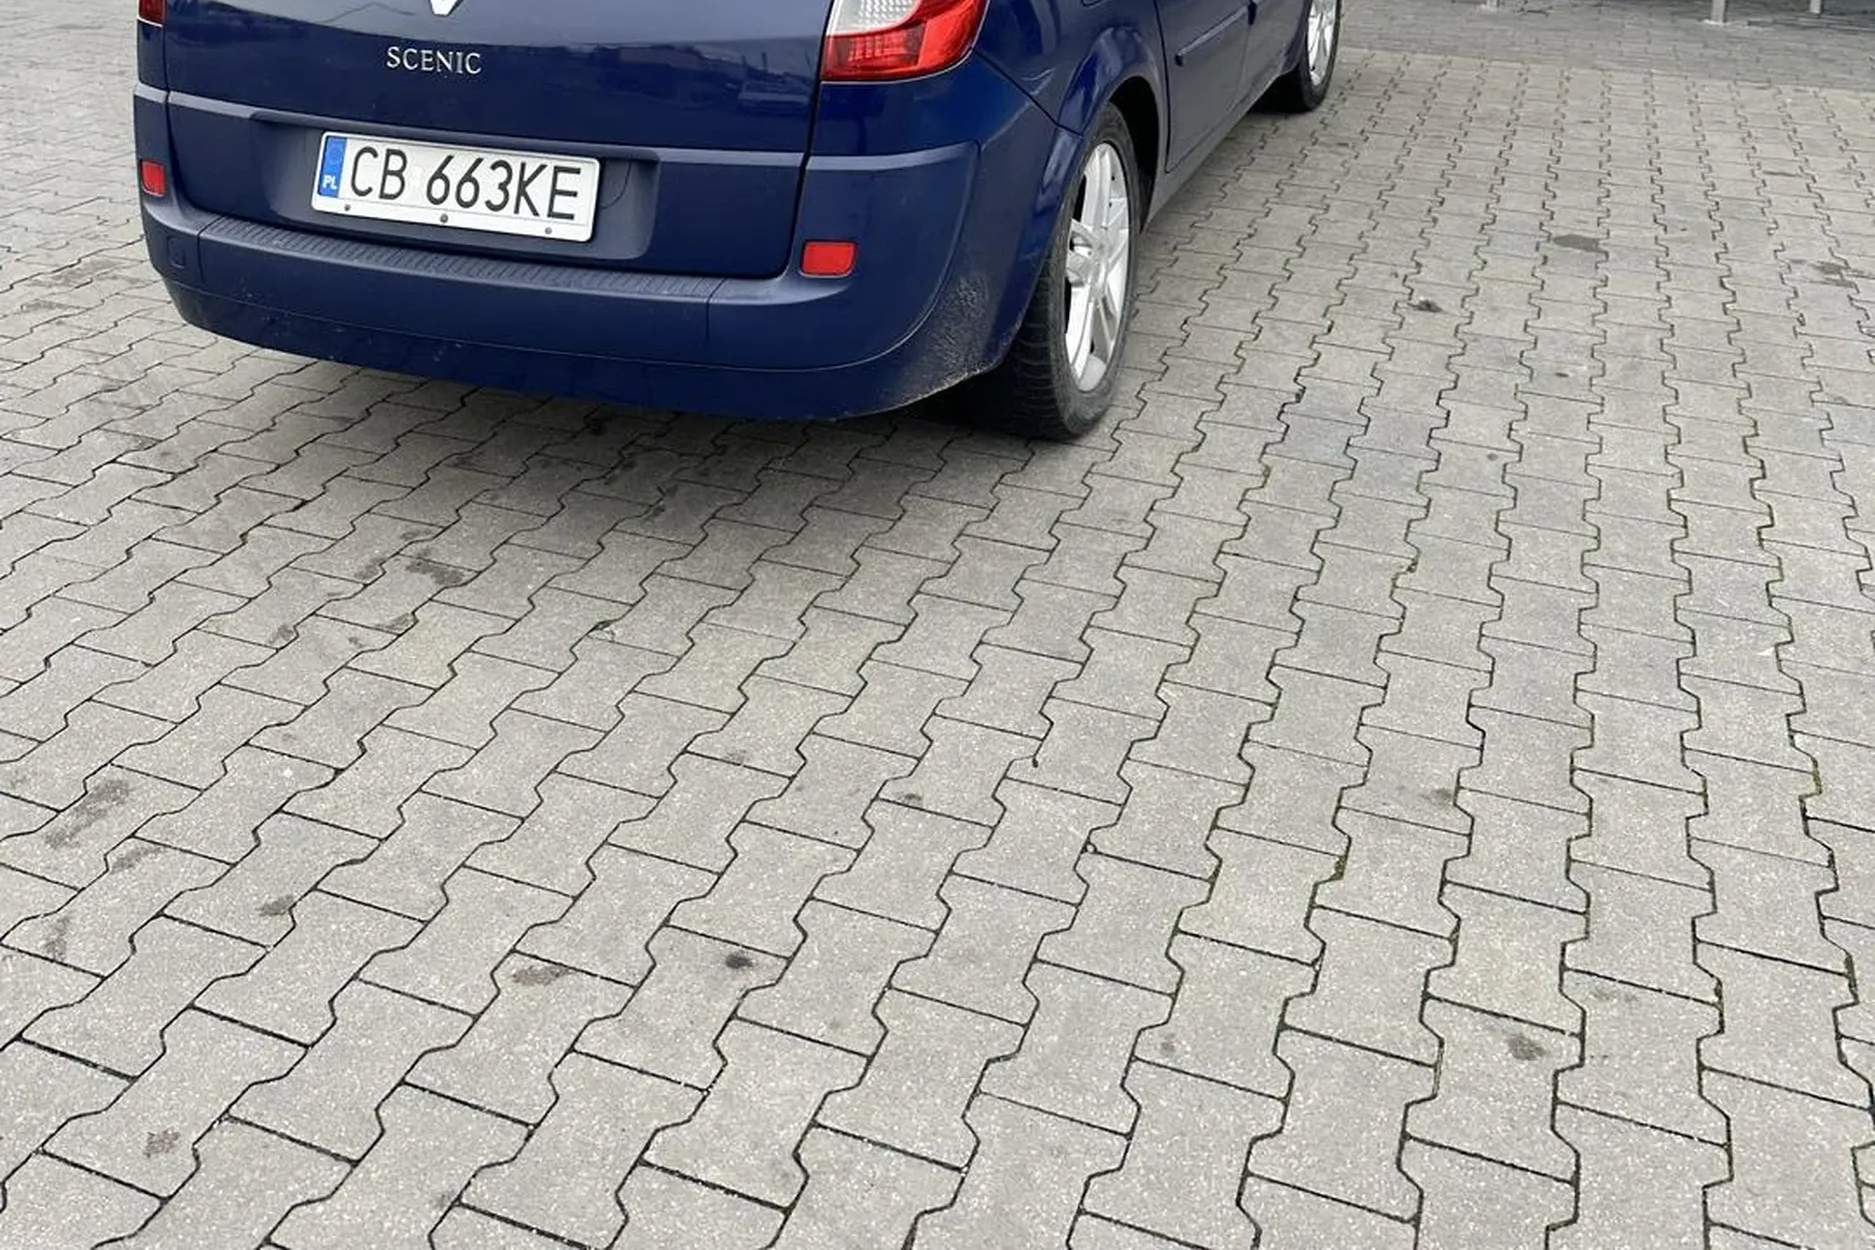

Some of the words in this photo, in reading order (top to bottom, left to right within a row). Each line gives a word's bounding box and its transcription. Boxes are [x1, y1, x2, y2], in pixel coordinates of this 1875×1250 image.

[386, 46, 482, 75] SCENIC
[321, 175, 338, 191] PL
[350, 146, 408, 201] CB
[426, 154, 582, 221] 663KE
